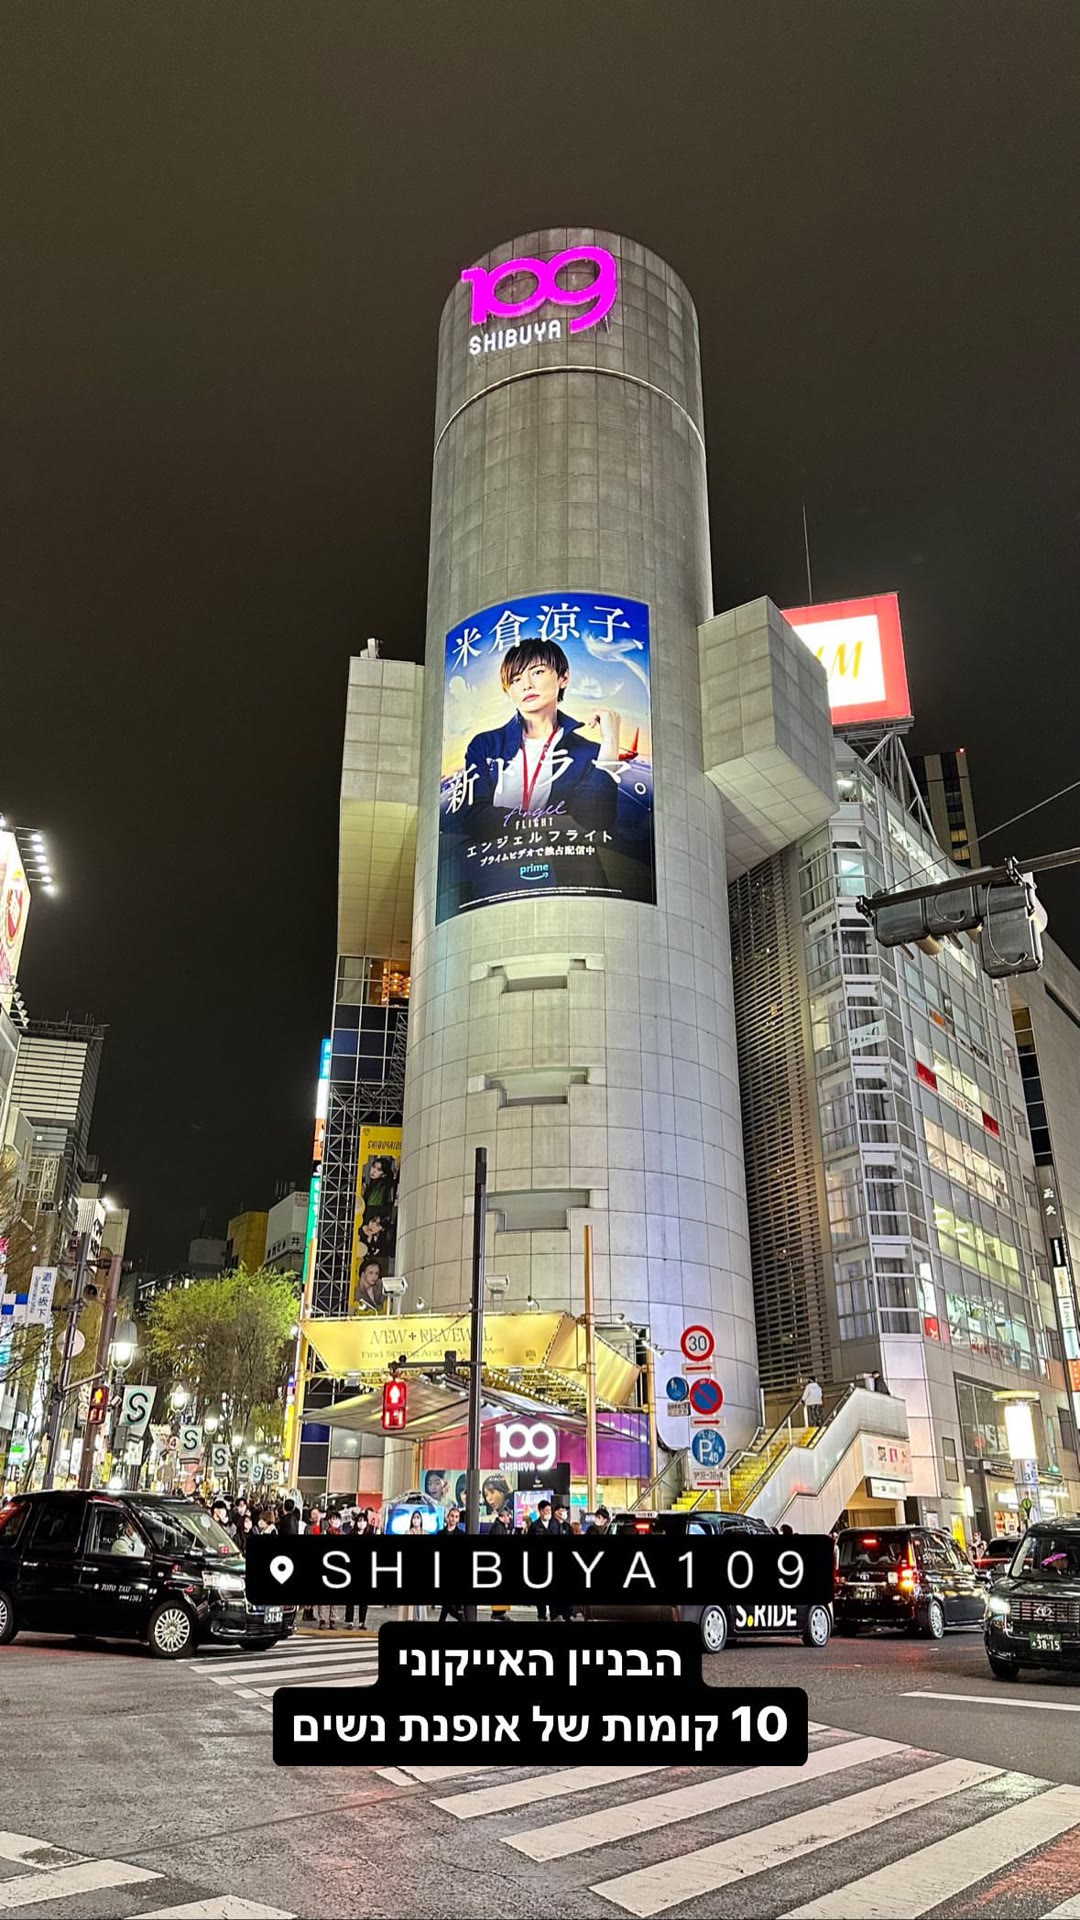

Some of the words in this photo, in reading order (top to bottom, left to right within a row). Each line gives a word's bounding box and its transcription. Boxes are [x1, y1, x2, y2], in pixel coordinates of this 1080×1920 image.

[460, 245, 617, 334] 109
[469, 319, 561, 356] SHIBUYA
[451, 602, 645, 673] 米倉涼子、
[445, 749, 647, 815] 新ドラマ。
[503, 800, 567, 827] Angel
[515, 817, 554, 830] FLIGHT
[466, 829, 613, 859] エンジェルフライト
[520, 863, 549, 876] prime
[370, 1328, 408, 1344] NEW
[419, 1327, 493, 1343] RENEWL
[688, 1335, 708, 1352] 30
[126, 1392, 149, 1424] S
[183, 1429, 199, 1451] S
[495, 1422, 556, 1471] 109
[699, 1439, 713, 1464] P
